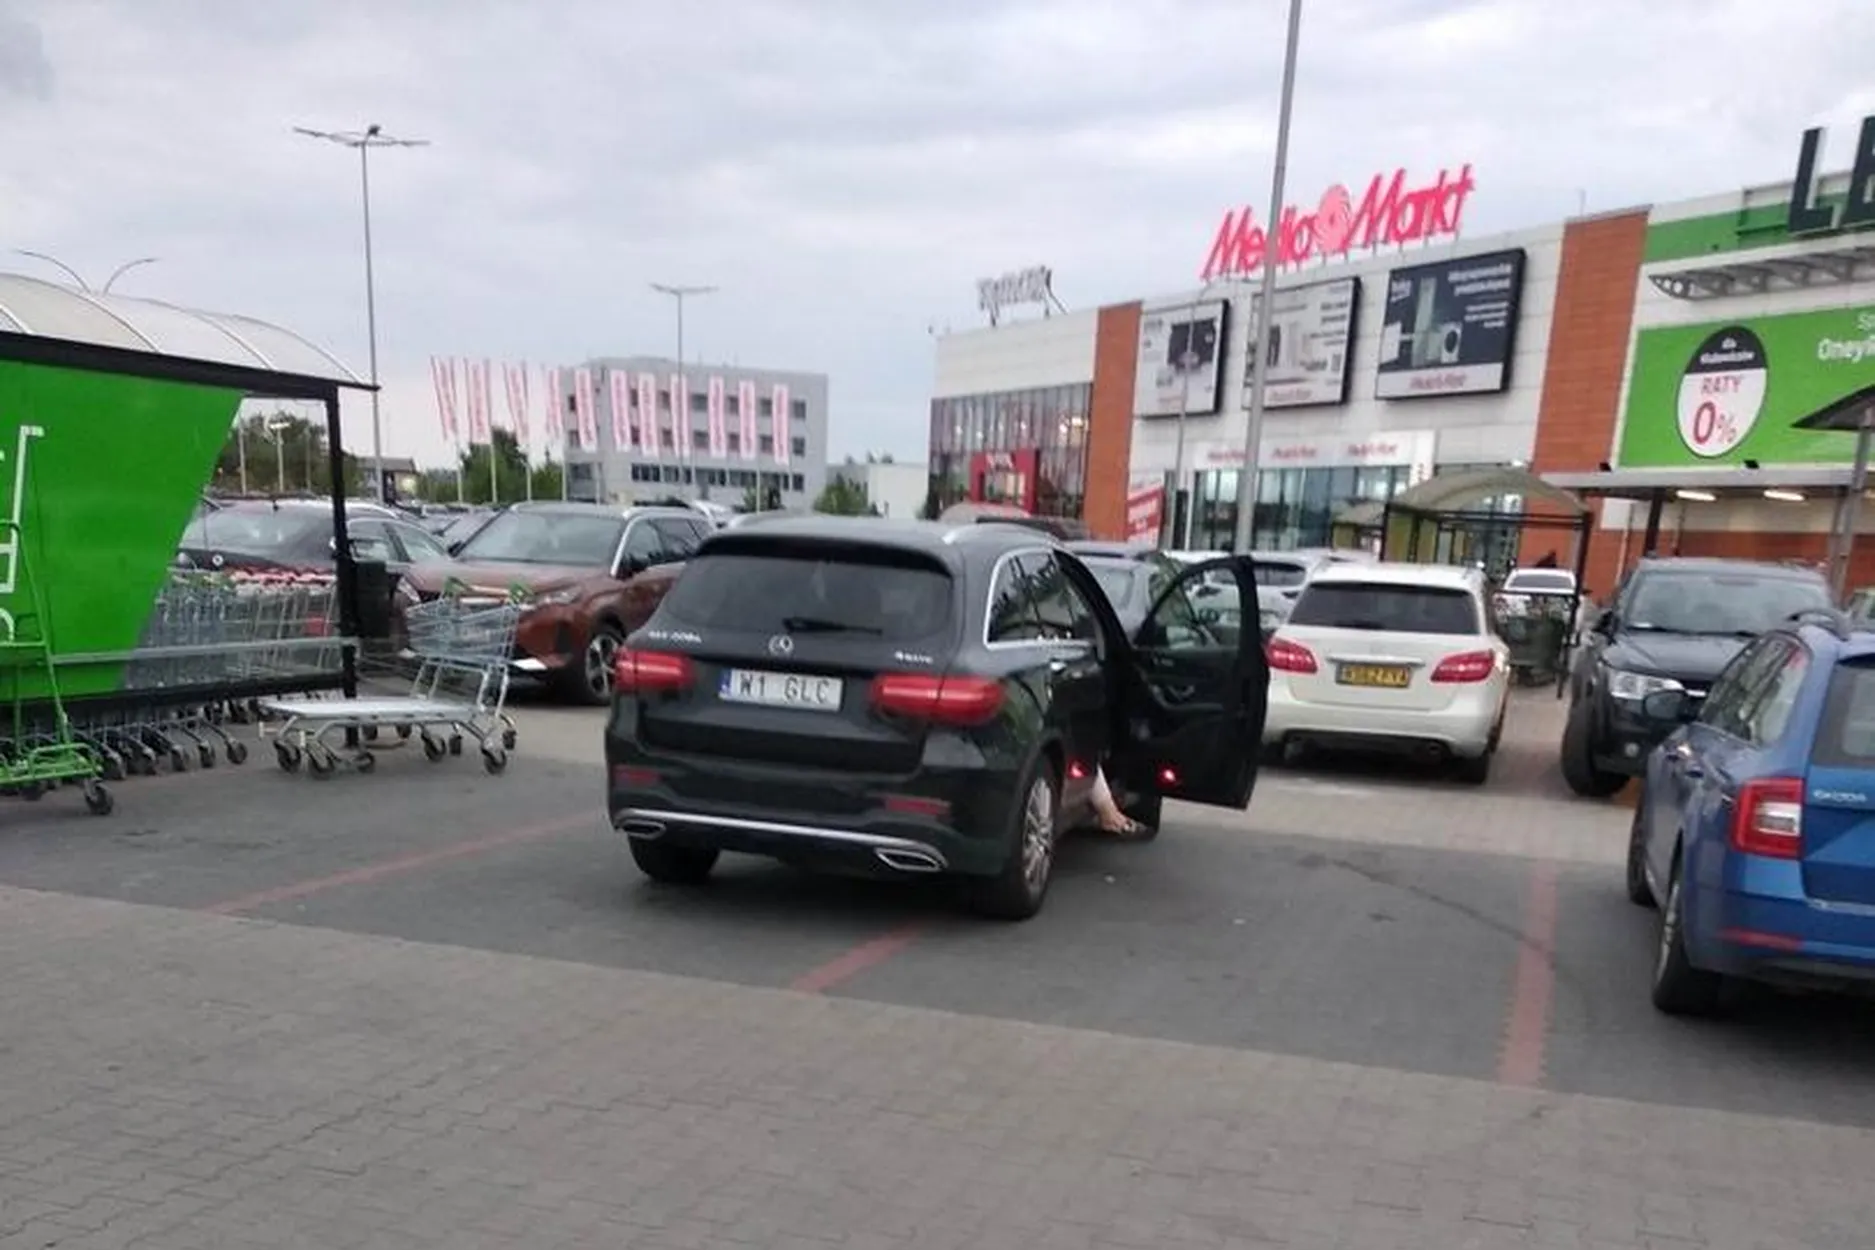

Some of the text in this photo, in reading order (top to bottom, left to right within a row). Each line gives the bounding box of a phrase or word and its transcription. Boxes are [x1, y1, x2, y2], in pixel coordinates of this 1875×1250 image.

[1200, 164, 1473, 281] Meia Markt
[1702, 376, 1741, 394] RATY
[1693, 401, 1738, 445] 0%
[740, 674, 766, 698] W1
[784, 677, 830, 704] GLC
